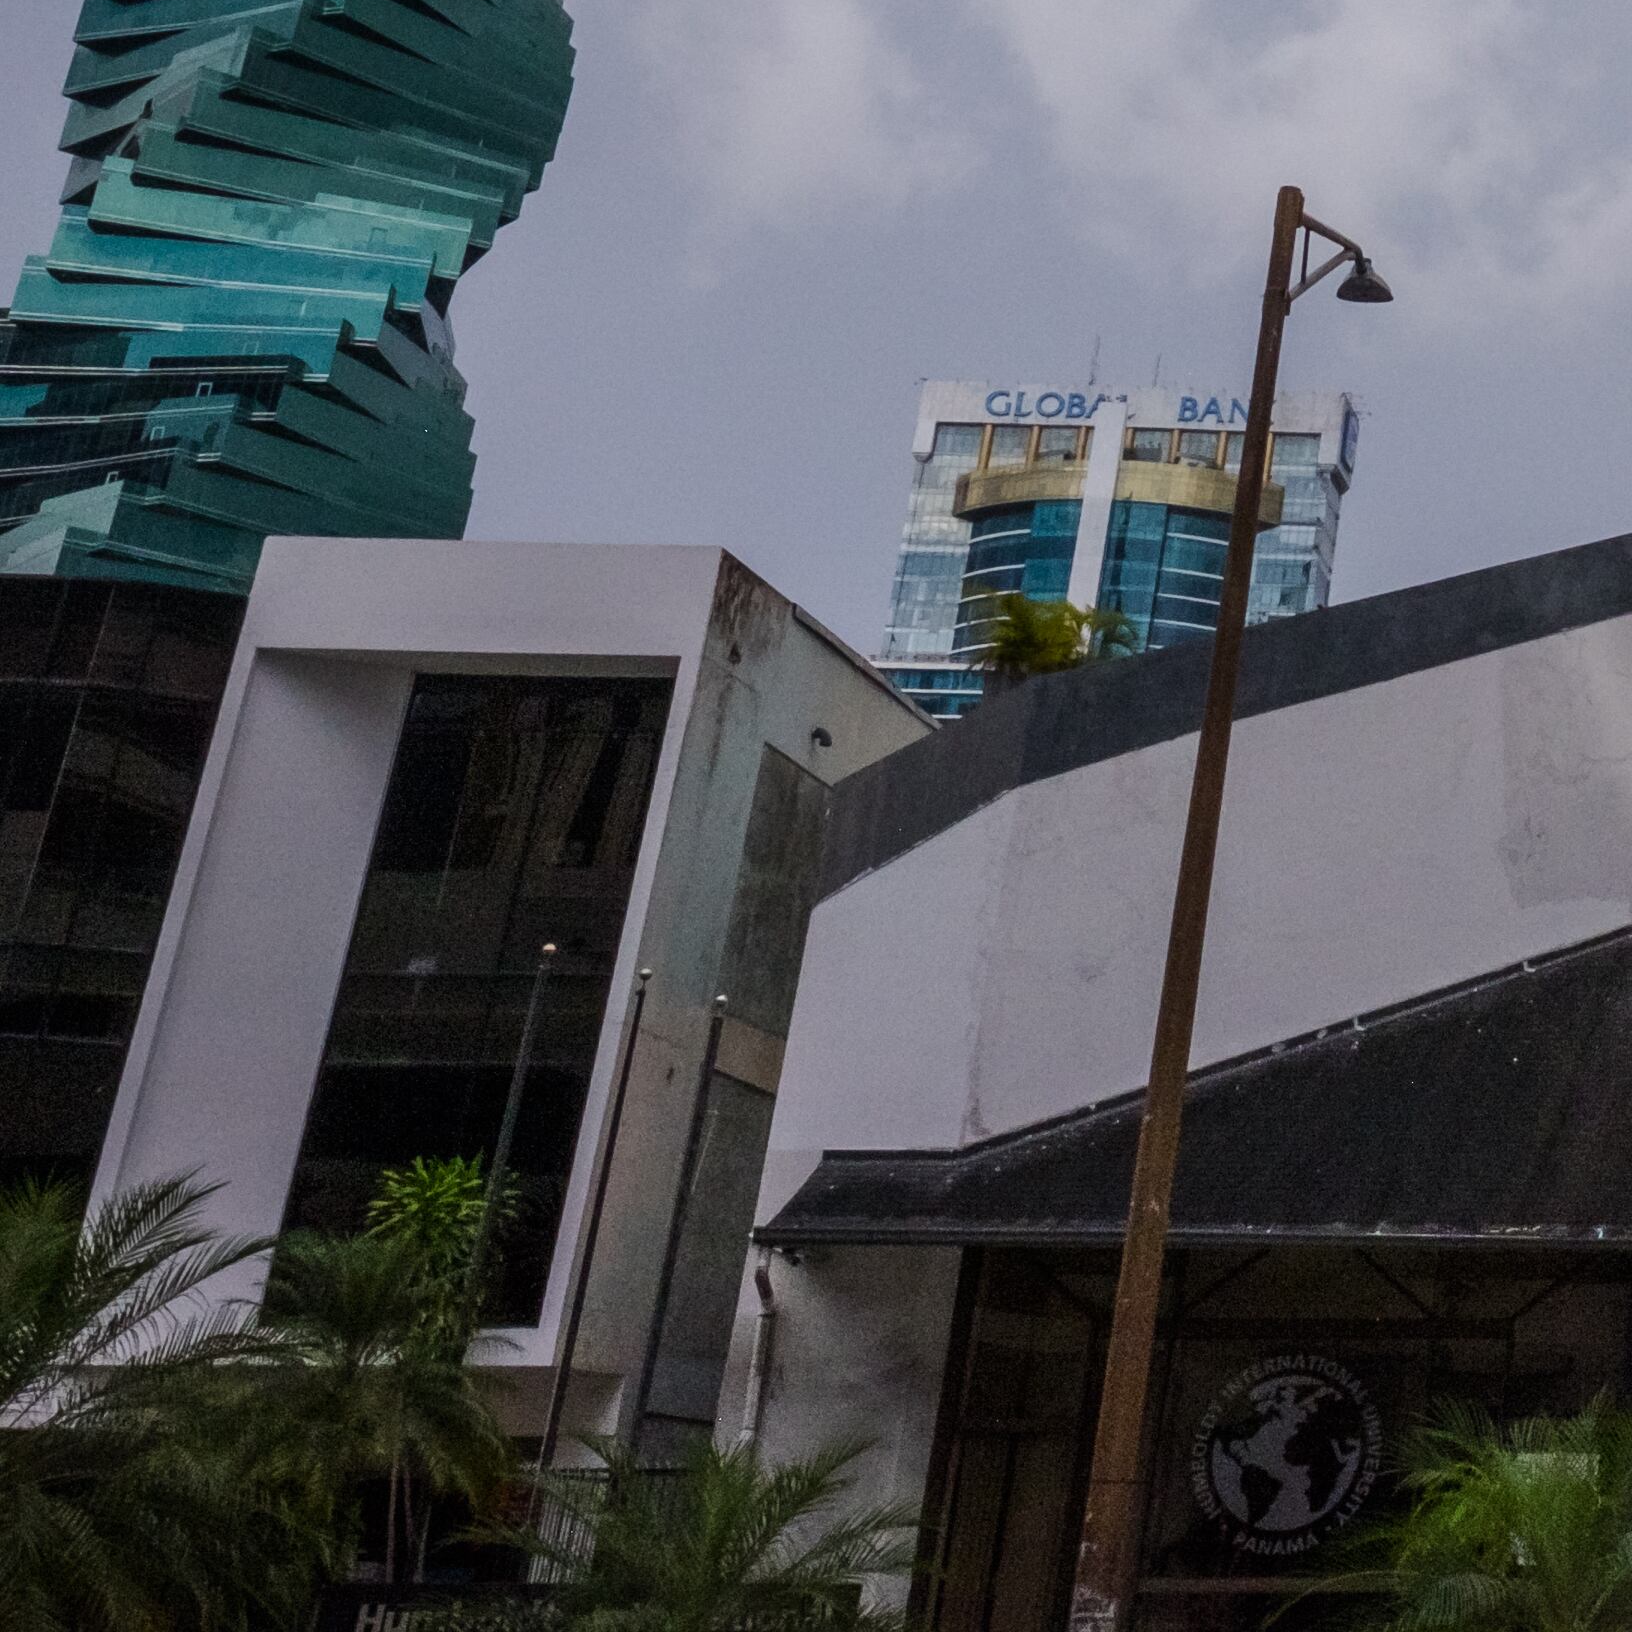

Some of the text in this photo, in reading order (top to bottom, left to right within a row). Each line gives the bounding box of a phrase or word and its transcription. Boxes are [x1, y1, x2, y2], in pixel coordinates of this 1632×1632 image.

[1177, 395, 1252, 423] BAN
[1190, 1353, 1383, 1526] HUMBOLDT INTERNATIONAL UNIVERSITY
[1232, 1530, 1320, 1556] PANAMA
